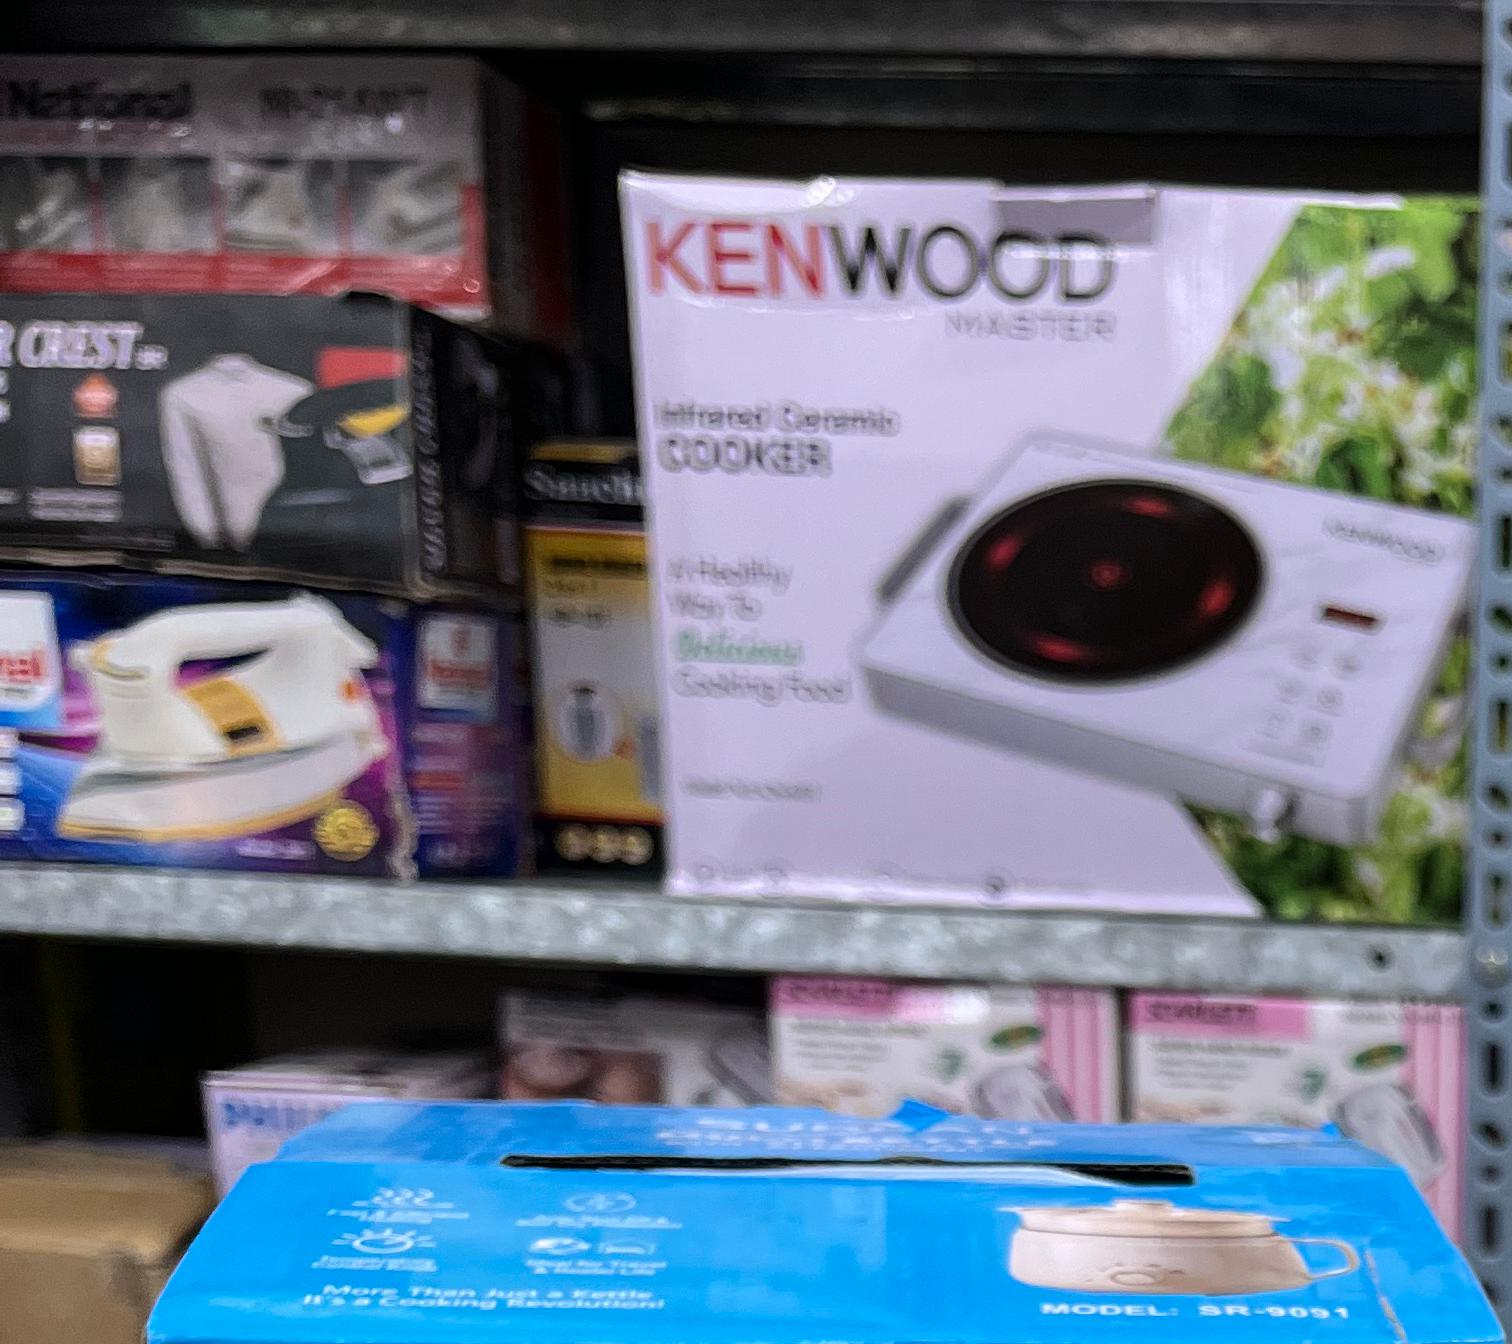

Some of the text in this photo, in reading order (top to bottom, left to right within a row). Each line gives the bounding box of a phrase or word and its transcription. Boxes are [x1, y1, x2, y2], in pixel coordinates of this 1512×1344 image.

[643, 219, 1119, 300] KENWOOD
[944, 308, 1117, 343] MASTER
[1040, 1302, 1350, 1320] MODEL: SR-9091
